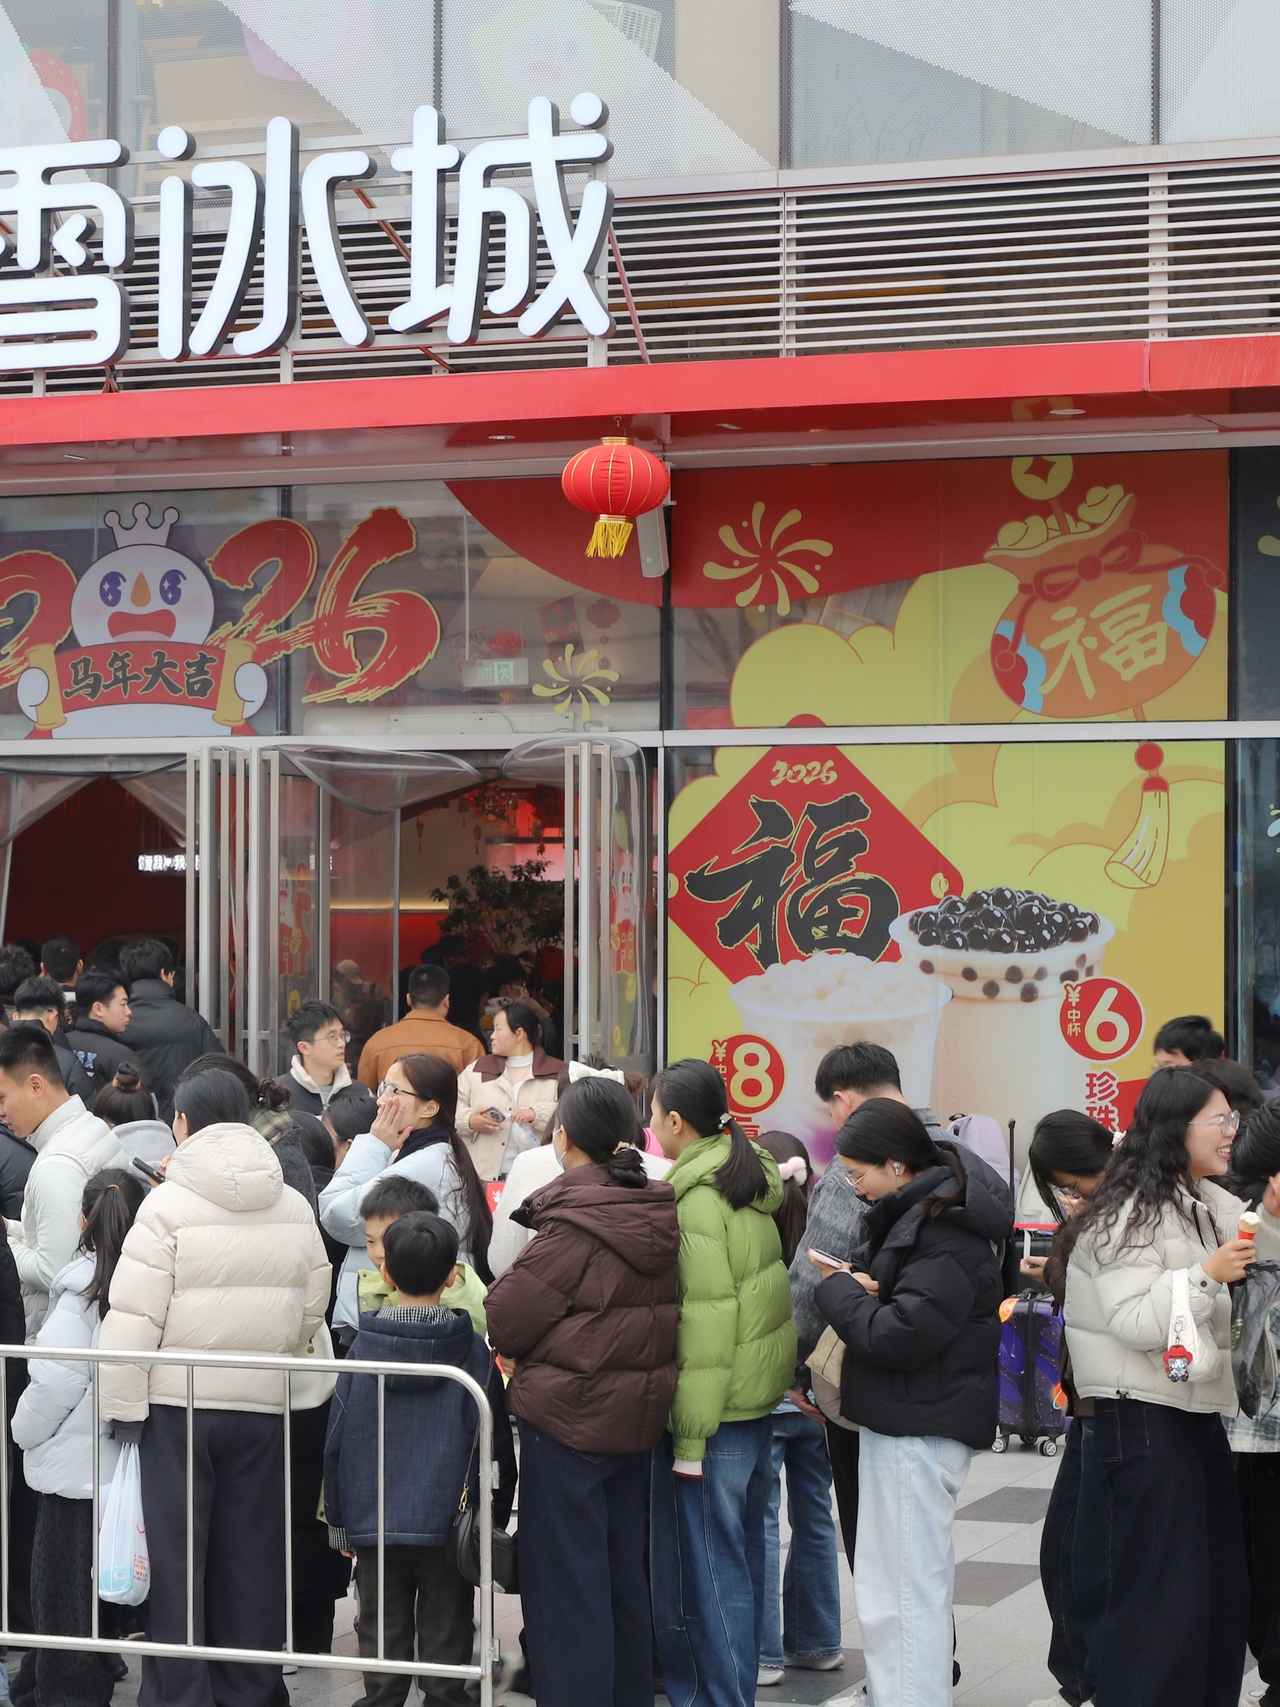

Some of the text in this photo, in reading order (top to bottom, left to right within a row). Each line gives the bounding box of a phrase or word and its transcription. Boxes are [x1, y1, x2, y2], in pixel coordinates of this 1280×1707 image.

[1038, 584, 1168, 700] 福
[63, 652, 218, 700] 马年大吉
[770, 760, 838, 786] 2026
[686, 793, 901, 970] 福
[1067, 1009, 1082, 1037] 中杯
[1085, 1071, 1117, 1133] 珍珠
